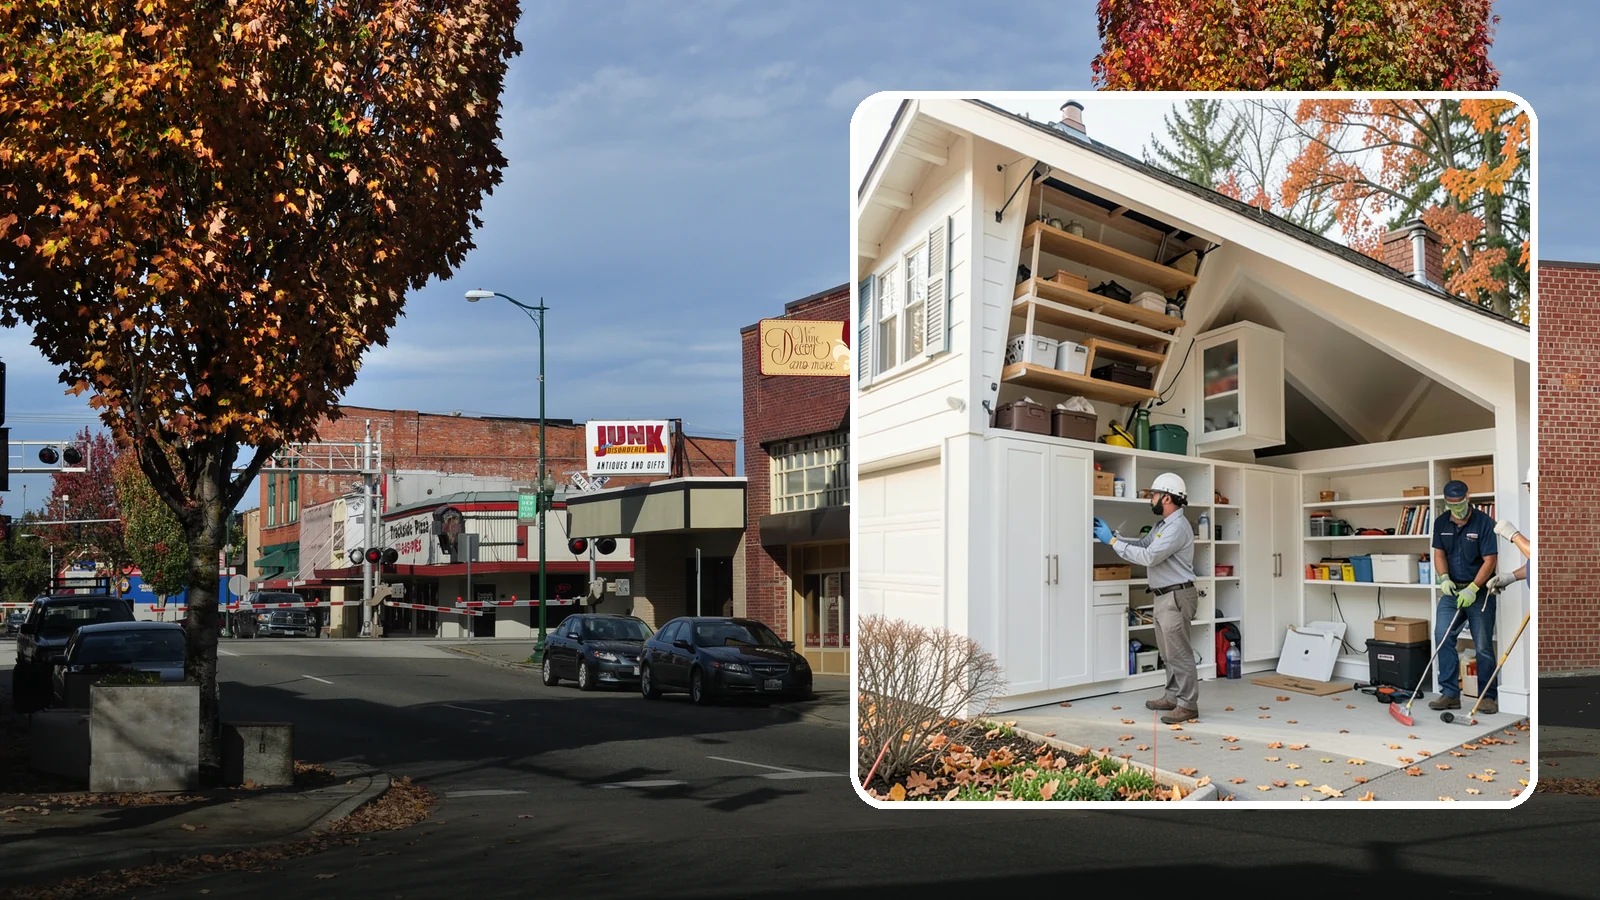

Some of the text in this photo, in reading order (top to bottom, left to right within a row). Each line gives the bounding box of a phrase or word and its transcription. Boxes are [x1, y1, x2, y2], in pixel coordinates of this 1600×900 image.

[596, 425, 664, 457] JUNK
[607, 446, 645, 454] DISORDERLY
[597, 460, 665, 470] ANTIQUES AND GIFTS
[414, 519, 429, 535] Pizza
